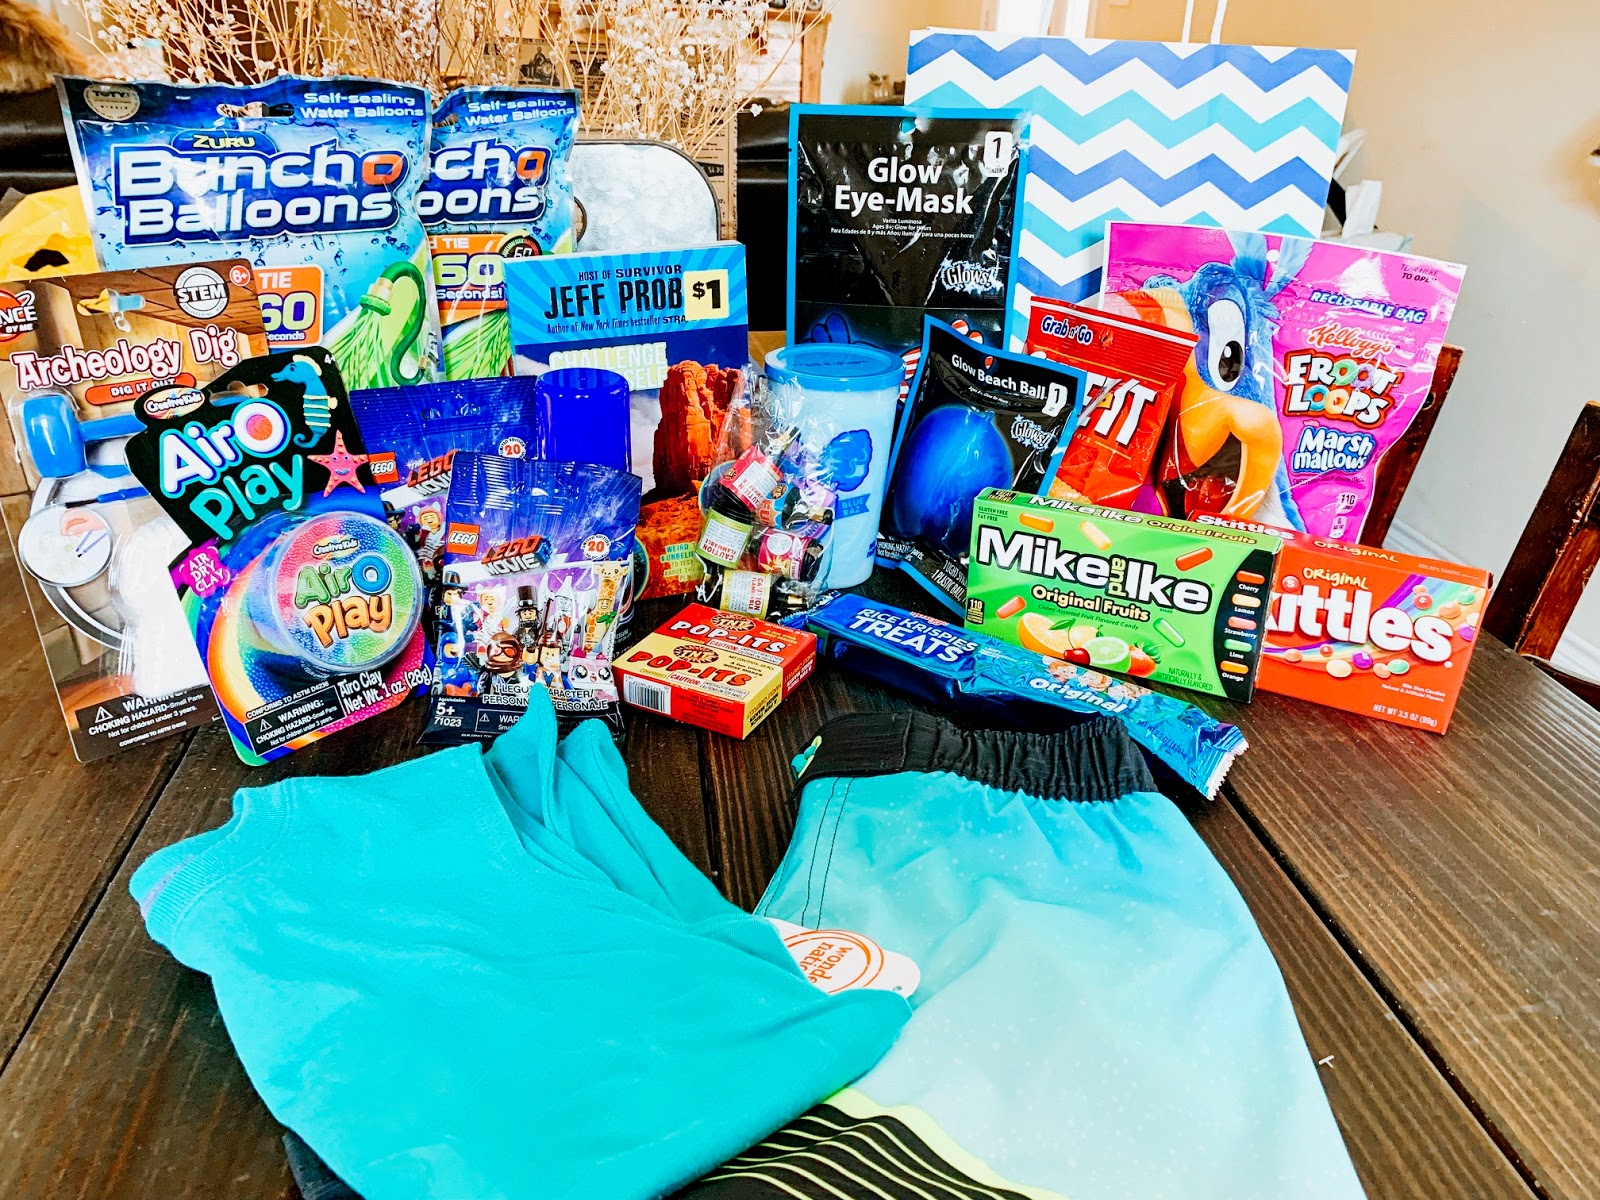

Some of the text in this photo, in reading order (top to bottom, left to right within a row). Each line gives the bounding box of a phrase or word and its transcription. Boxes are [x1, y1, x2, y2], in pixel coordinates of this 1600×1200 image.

[303, 92, 415, 106] Self-sealing
[468, 99, 567, 113] Self-sealing
[300, 106, 424, 119] Water Balloons
[465, 107, 575, 127] Water Balloons
[193, 134, 256, 149] ZURU
[993, 137, 1001, 158] 1
[868, 157, 944, 184] Glow
[129, 188, 393, 236] Balloons
[835, 185, 974, 218] Eye-Mask
[443, 237, 469, 249] TIE
[232, 269, 247, 283] 6+
[258, 271, 292, 289] TIE
[434, 254, 504, 286] 60
[578, 265, 682, 281] HOST OF SURVIVOR
[1402, 272, 1413, 280] TO
[177, 284, 226, 303] STEM
[437, 289, 503, 299] Seconds!
[544, 283, 605, 320] JEFF
[692, 279, 722, 309] $1
[1311, 290, 1427, 324] RECLOSABLE BAG
[6, 323, 33, 334] BY ME
[547, 324, 569, 334] Author
[571, 322, 578, 332] of
[580, 321, 594, 331] New
[596, 319, 610, 330] York
[612, 317, 629, 329] Times
[631, 315, 661, 327] bestseller
[1042, 315, 1069, 338] Grab
[1078, 325, 1093, 344] Go
[1309, 324, 1394, 357] Kellogg's
[12, 325, 240, 391] Archeology Dig
[549, 341, 667, 370] CHALLENGE
[951, 354, 976, 377] Glow
[977, 368, 1017, 391] Beach
[1020, 380, 1046, 400] Ball
[1289, 353, 1398, 397] FROOT
[110, 386, 133, 397] DIG
[135, 382, 148, 393] IT
[1289, 384, 1389, 424] LOOPS
[505, 443, 522, 455] 20
[370, 461, 394, 475] LEGO
[189, 454, 304, 541] Play
[842, 498, 864, 509] BLUE
[843, 507, 861, 516] RAZ
[978, 506, 996, 514] GLUTEN
[1028, 495, 1097, 516] Mike
[1100, 508, 1144, 524] Ike
[1147, 519, 1257, 545] Original Fruits
[1196, 514, 1295, 541] Skittles
[450, 532, 477, 545] LEGO
[588, 541, 604, 553] 20
[667, 543, 689, 553] WEIRD
[188, 552, 211, 569] AIR
[481, 535, 543, 565] LEGO
[702, 544, 734, 561] CAUTION
[979, 526, 1110, 587] Mike
[191, 561, 217, 581] DRY
[485, 554, 542, 576] MOVIE
[195, 570, 225, 593] CLAY
[1111, 557, 1127, 598] and
[1125, 562, 1211, 613] Ike
[1238, 584, 1259, 593] Cherry
[970, 598, 983, 610] 110
[1032, 585, 1151, 622] Original Fruits
[1234, 606, 1255, 615] Lemon
[304, 595, 392, 648] Play
[1038, 604, 1139, 631] Chewy Assorted Fruit Flavored Candy
[669, 620, 787, 654] POP-ITS
[847, 615, 965, 662] TREATS
[857, 608, 979, 652] RICE KRISPIES
[1224, 627, 1257, 640] Strawberry
[1229, 651, 1244, 660] Lime
[627, 650, 752, 686] POP-ITS
[1168, 667, 1197, 680] NATURALLY
[1222, 672, 1244, 682] Orange
[338, 671, 383, 698] Airo Clay
[344, 664, 433, 714] Net Wt. oz. (28g)
[246, 700, 283, 719] CONFORMS
[284, 695, 292, 704] TO
[293, 688, 311, 701] ASTM
[1029, 678, 1128, 713] Original
[89, 693, 204, 736] CHOKING Parts
[278, 699, 325, 723] WARNING:
[436, 702, 455, 716] 5+
[1373, 704, 1419, 722] NET WT 3.5 OZ
[108, 705, 198, 739] Not for children under years.
[434, 716, 461, 727] 71023
[256, 725, 286, 745] CHOKING
